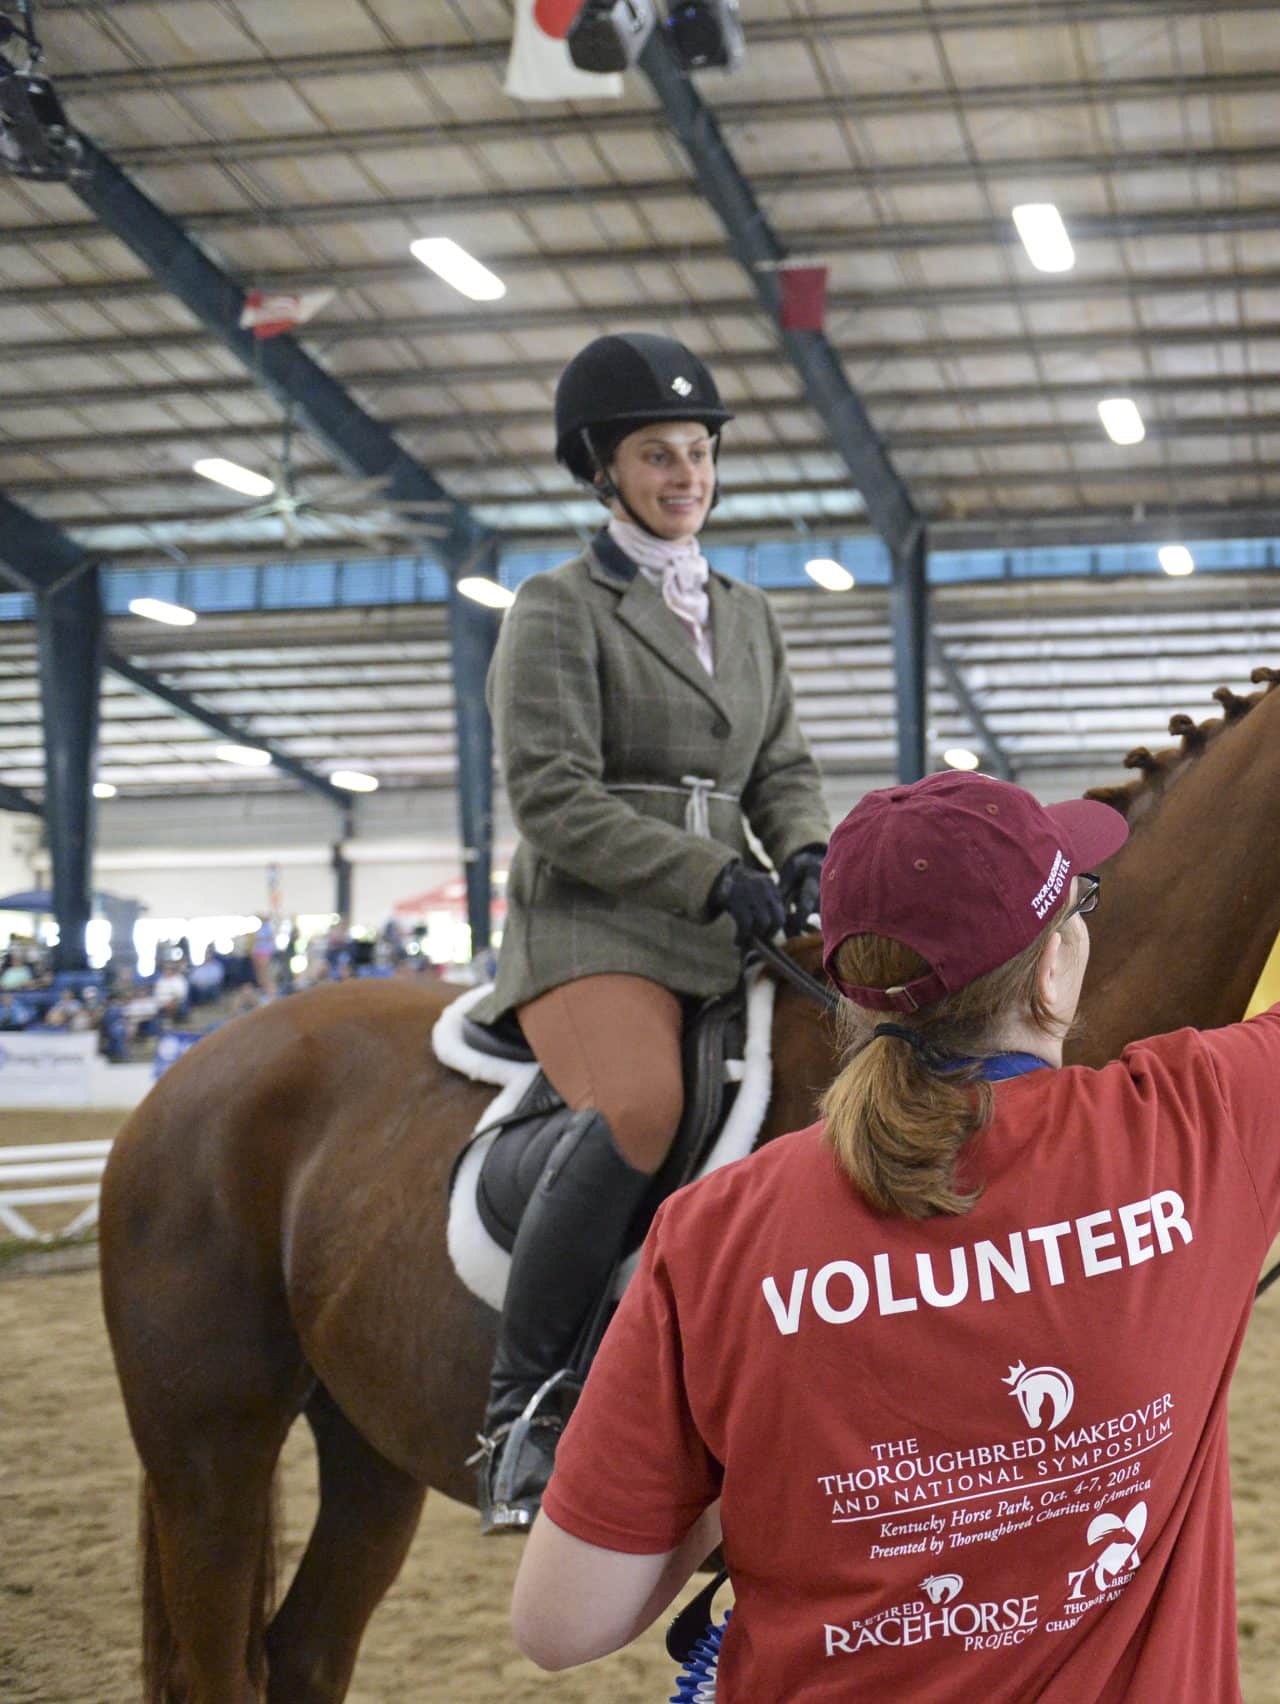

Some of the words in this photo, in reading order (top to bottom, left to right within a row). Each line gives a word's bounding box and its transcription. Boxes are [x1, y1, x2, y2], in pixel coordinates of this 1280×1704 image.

[1036, 858, 1071, 919] MAKEOVER
[761, 1189, 1193, 1336] VOLUNTEER
[817, 1437, 1046, 1496] THOROUGHBRED
[1054, 1393, 1175, 1451] MAKEOVER
[832, 1495, 880, 1515] AND
[894, 1465, 1024, 1505] NATIONAL
[1037, 1417, 1172, 1476] SYMPOSIUM
[870, 1438, 919, 1461] THE
[869, 1536, 927, 1560] Presented
[930, 1536, 944, 1555] by
[949, 1515, 1033, 1549] Thoroughbred
[1036, 1500, 1090, 1522] Charities
[1094, 1493, 1109, 1511] of
[1106, 1479, 1151, 1503] America
[880, 1514, 946, 1538] Kentucky
[951, 1508, 992, 1527] Horse
[997, 1495, 1034, 1518] Park,
[1040, 1491, 1068, 1506] Oct.
[1073, 1477, 1102, 1495] 4-7,
[1107, 1461, 1141, 1487] 2018
[824, 1595, 1040, 1656] RACEHORSE
[852, 1601, 925, 1631] RETIRED
[964, 1625, 1039, 1651] PROJECT
